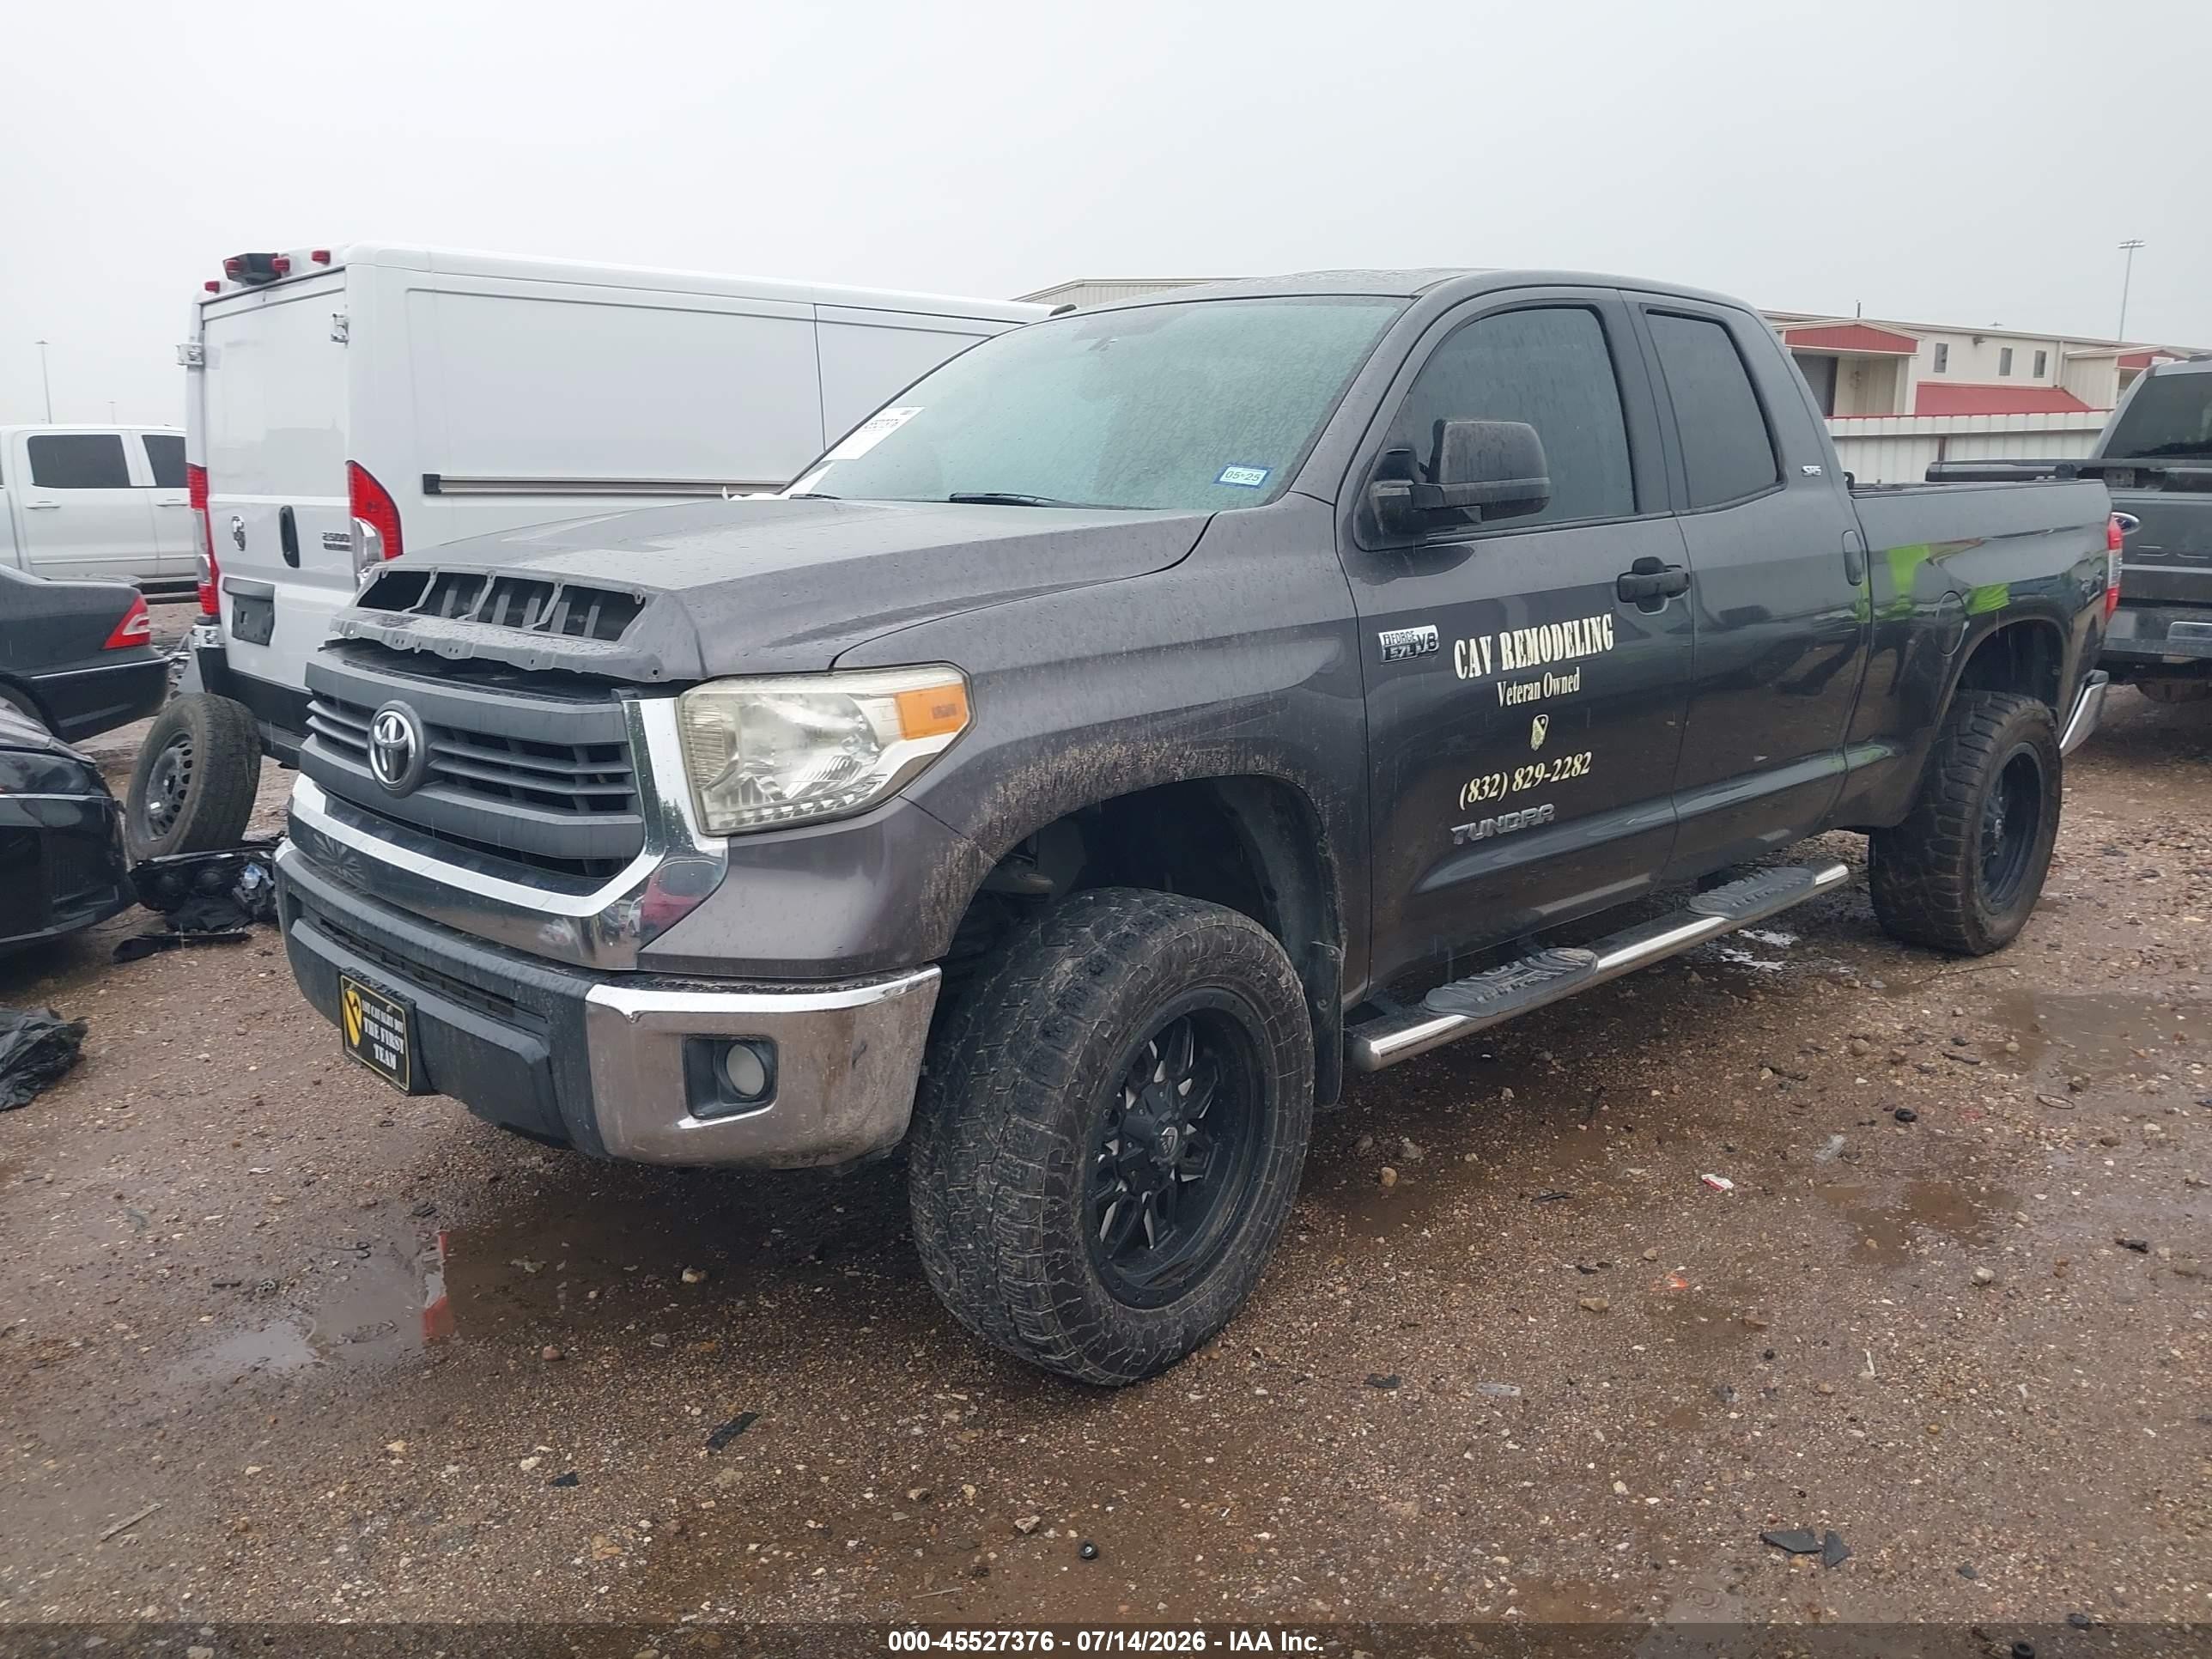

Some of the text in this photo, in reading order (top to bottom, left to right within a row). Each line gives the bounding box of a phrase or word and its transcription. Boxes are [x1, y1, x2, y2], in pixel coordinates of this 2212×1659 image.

[1416, 631, 1439, 653] V8
[1454, 613, 1614, 680] CAV REMODELING
[1497, 665, 1581, 708] Veteran Owned
[1459, 750, 1593, 811] (832) 829-2282
[1449, 803, 1555, 845] TUNDRA
[362, 1016, 380, 1041] THE
[380, 1025, 405, 1054] FIRST
[373, 1042, 398, 1071] TEAM
